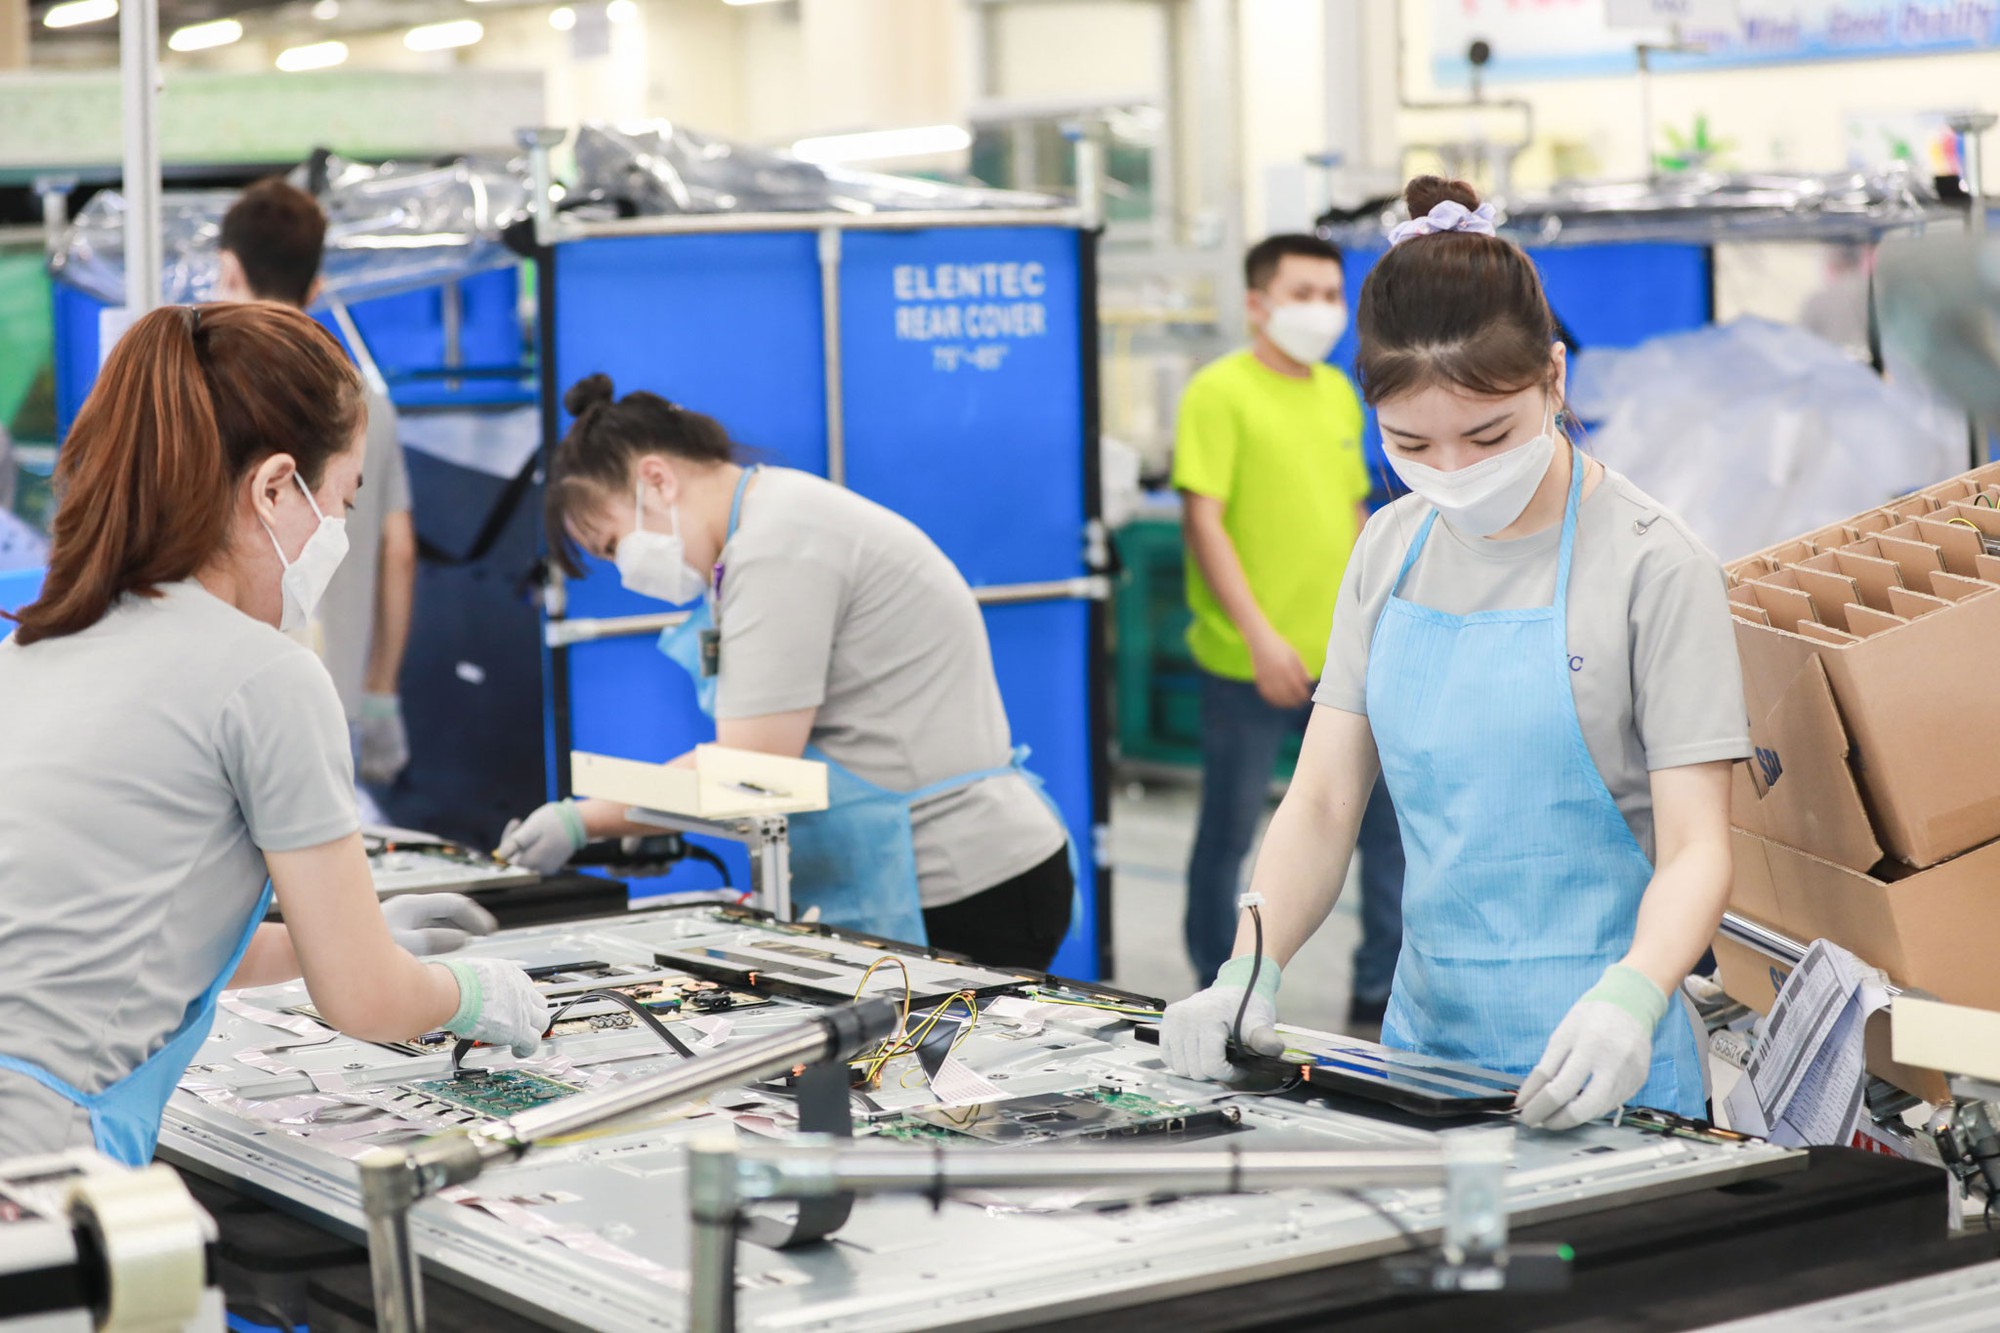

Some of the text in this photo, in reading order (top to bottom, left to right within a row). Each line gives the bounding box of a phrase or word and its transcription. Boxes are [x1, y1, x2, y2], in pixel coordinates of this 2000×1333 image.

[894, 261, 1046, 300] ELENTEC
[896, 302, 1047, 341] REAR COVER
